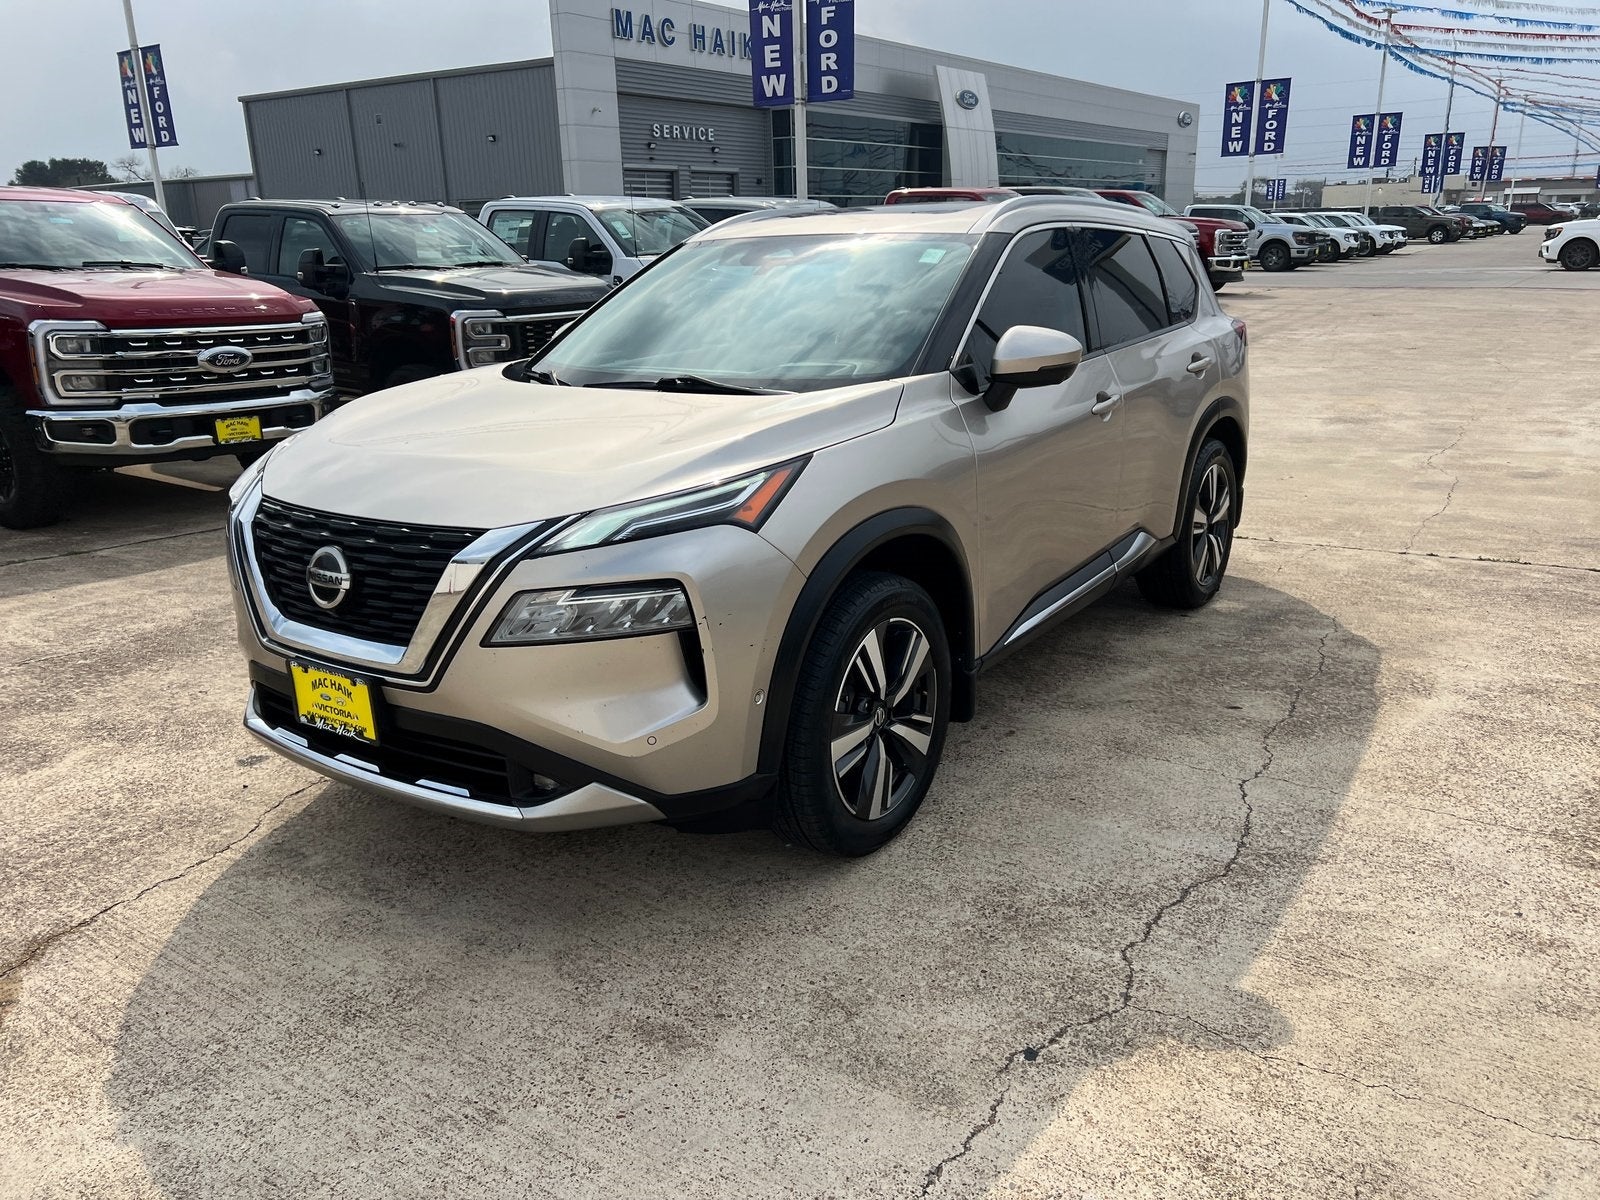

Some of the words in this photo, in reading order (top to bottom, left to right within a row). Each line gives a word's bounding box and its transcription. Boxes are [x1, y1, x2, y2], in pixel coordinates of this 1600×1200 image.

[612, 8, 676, 47] MAC
[690, 23, 752, 60] HAIK
[761, 14, 787, 98] NEW
[819, 6, 839, 94] FORD
[126, 88, 145, 143] NEW
[153, 86, 170, 143] FORD
[653, 123, 715, 141] SERVICE
[1228, 111, 1243, 153] NEW
[1263, 109, 1278, 152] FORD
[1353, 135, 1366, 166] NEW
[1380, 134, 1392, 165] FORD
[1425, 150, 1436, 174] NEW
[1447, 149, 1457, 173] FORD
[1473, 160, 1482, 179] NEW
[1491, 159, 1499, 180] FORD
[215, 353, 240, 366] Ford
[310, 571, 342, 586] NISSAN
[311, 677, 329, 692] MAC
[330, 679, 354, 703] HAIK
[318, 703, 353, 719] VICTORIA
[314, 717, 336, 732] Mac
